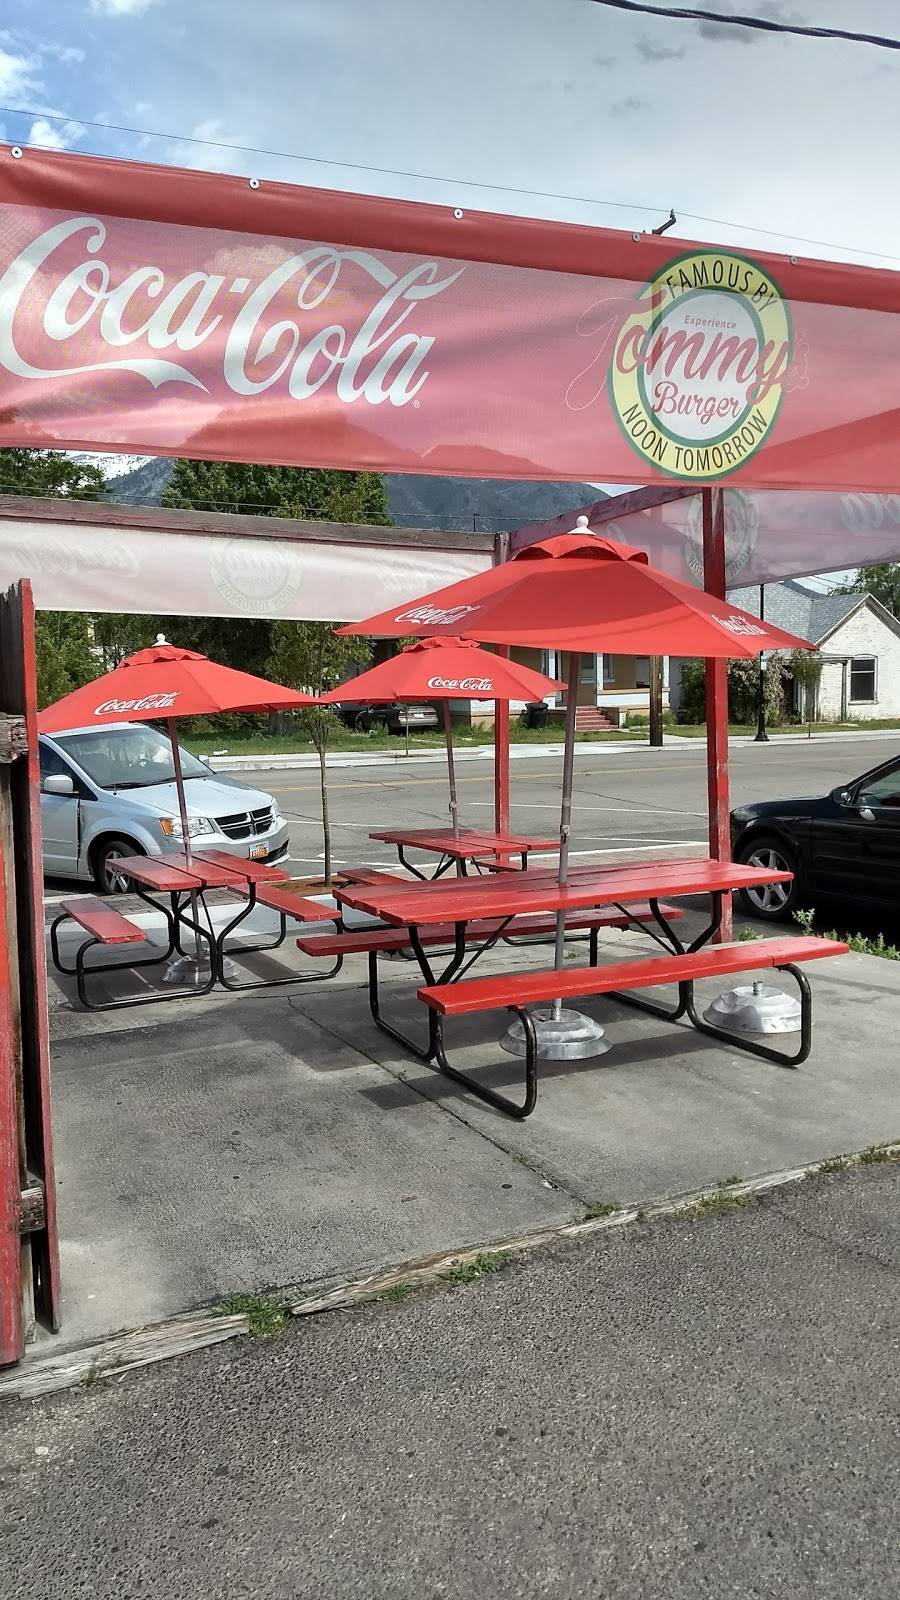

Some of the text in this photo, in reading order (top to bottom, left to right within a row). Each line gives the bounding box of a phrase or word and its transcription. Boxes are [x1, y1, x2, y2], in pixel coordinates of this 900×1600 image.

[665, 259, 778, 312] FAMOUS BY
[0, 217, 466, 408] Coca-Cola
[684, 314, 737, 329] Experience
[651, 380, 741, 425] Burger
[622, 403, 768, 471] NOON TOMORROW
[93, 690, 184, 716] Coca-Cola
[427, 676, 494, 691] Coca-Cola
